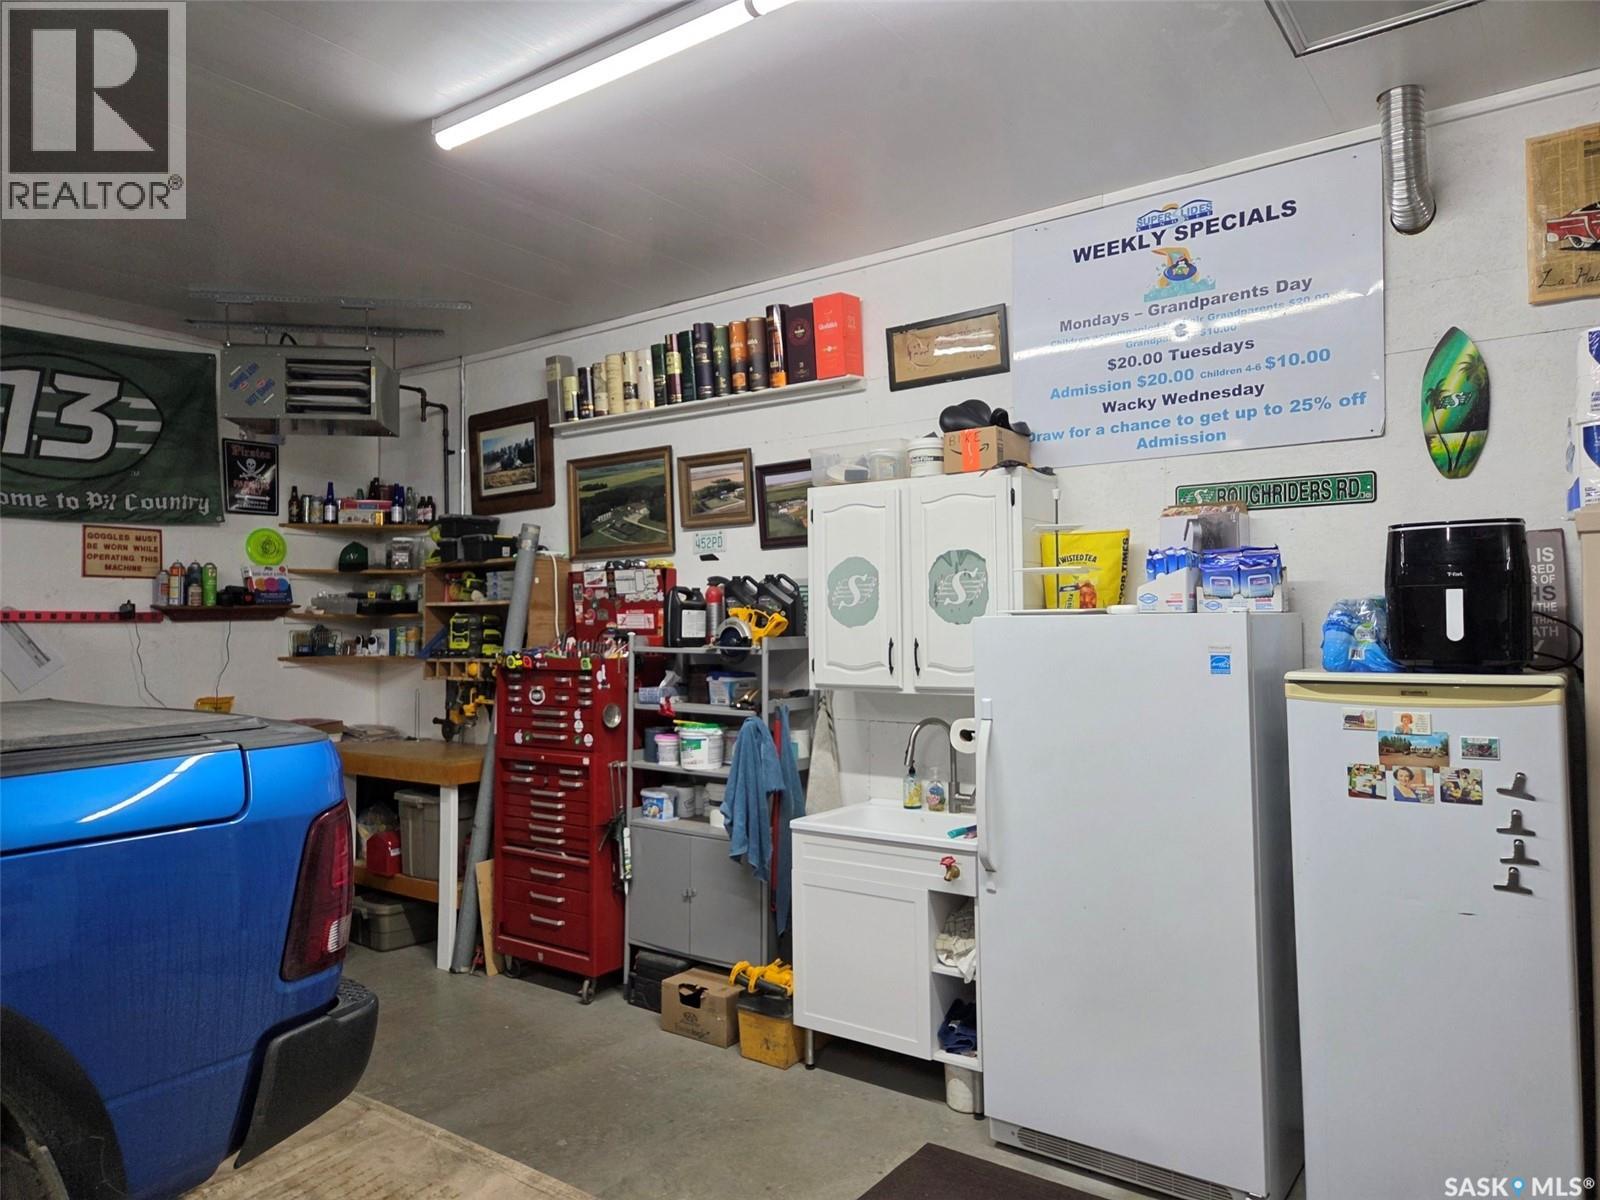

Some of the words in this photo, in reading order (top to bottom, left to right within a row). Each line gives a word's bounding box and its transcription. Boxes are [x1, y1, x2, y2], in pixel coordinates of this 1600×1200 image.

[1073, 230, 1166, 263] WEEKLY
[1174, 200, 1297, 242] SPECIALS
[1060, 311, 1130, 332] Mondays
[1148, 285, 1269, 316] Grandparents
[1276, 278, 1312, 294] Day
[1107, 351, 1163, 371] $20.00
[1168, 339, 1255, 361] Tuesdays
[1050, 379, 1131, 400] Admission
[1137, 368, 1194, 388] $20.00
[1200, 367, 1242, 379] Children
[1245, 363, 1262, 372] 4-6
[1265, 348, 1331, 370] $10.00
[1102, 397, 1157, 413] Wacky
[1162, 383, 1265, 406] Wednesday
[1069, 426, 1090, 438] for
[1096, 426, 1105, 435] a
[1110, 417, 1171, 434] chance
[1177, 414, 1194, 426] to
[1200, 408, 1230, 426] get
[1236, 407, 1258, 421] up
[1264, 403, 1283, 416] to
[1289, 395, 1332, 413] 25%
[1339, 391, 1367, 408] off
[1136, 430, 1226, 450] Admission
[56, 491, 79, 510] to
[125, 492, 210, 515] Country
[1216, 478, 1332, 505] ROUGHRIDERS
[87, 532, 130, 541] GOGGLES
[87, 542, 98, 550] BE
[104, 543, 129, 551] WORN
[133, 544, 158, 552] WHILE
[87, 553, 135, 562] OPERATING
[141, 555, 158, 563] THIS
[1058, 554, 1085, 565] WISTED
[1536, 547, 1555, 562] IS
[105, 564, 142, 572] MACHINE
